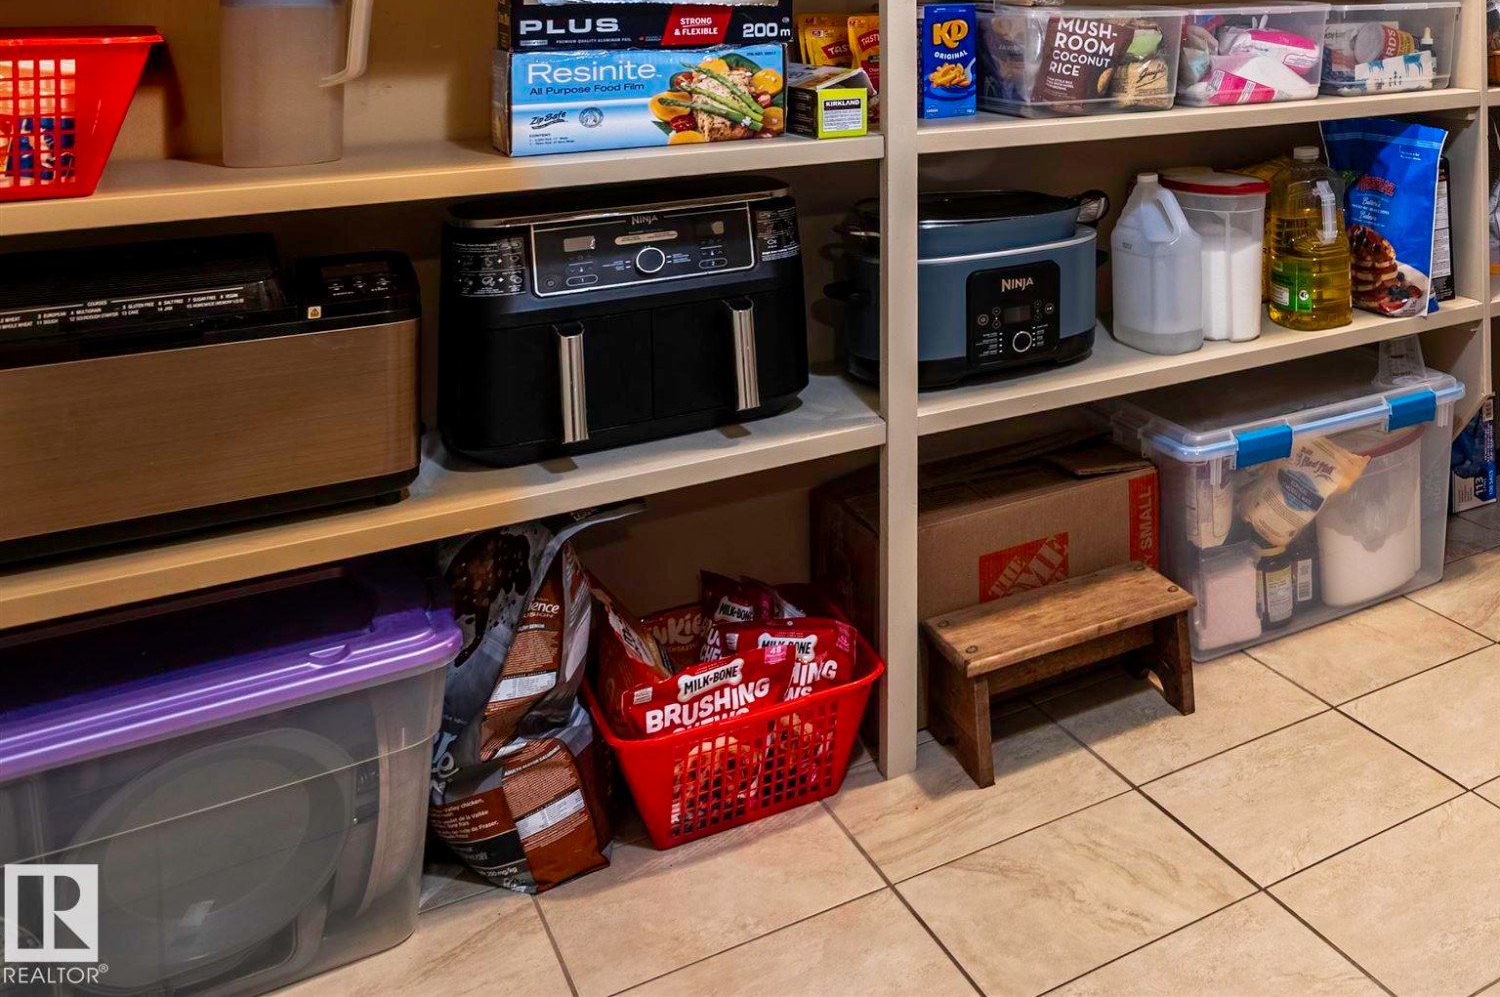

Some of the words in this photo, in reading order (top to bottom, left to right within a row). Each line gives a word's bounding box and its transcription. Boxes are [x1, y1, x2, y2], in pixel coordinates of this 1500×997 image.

[519, 18, 619, 35] PLUS
[680, 17, 712, 25] STRONG
[1058, 18, 1118, 39] MUSH-
[682, 27, 718, 35] FLEXIBLE
[743, 23, 778, 38] 200
[780, 28, 791, 36] m
[1054, 32, 1115, 57] ROOM
[934, 49, 968, 60] ORIGINAL
[1052, 50, 1111, 68] COCONUT
[527, 61, 657, 84] Resinite
[1049, 61, 1080, 77] RICE
[529, 86, 543, 95] All
[545, 85, 591, 96] Purpose
[594, 84, 621, 92] Food
[623, 83, 645, 91] Film
[825, 99, 860, 107] KIRKLAND
[632, 215, 658, 226] NINJA
[1001, 277, 1034, 293] NINJA
[1475, 476, 1484, 496] 113
[1139, 486, 1152, 550] SMALL
[684, 665, 739, 695] MILK-BONE
[646, 677, 771, 735] BRUSHING
